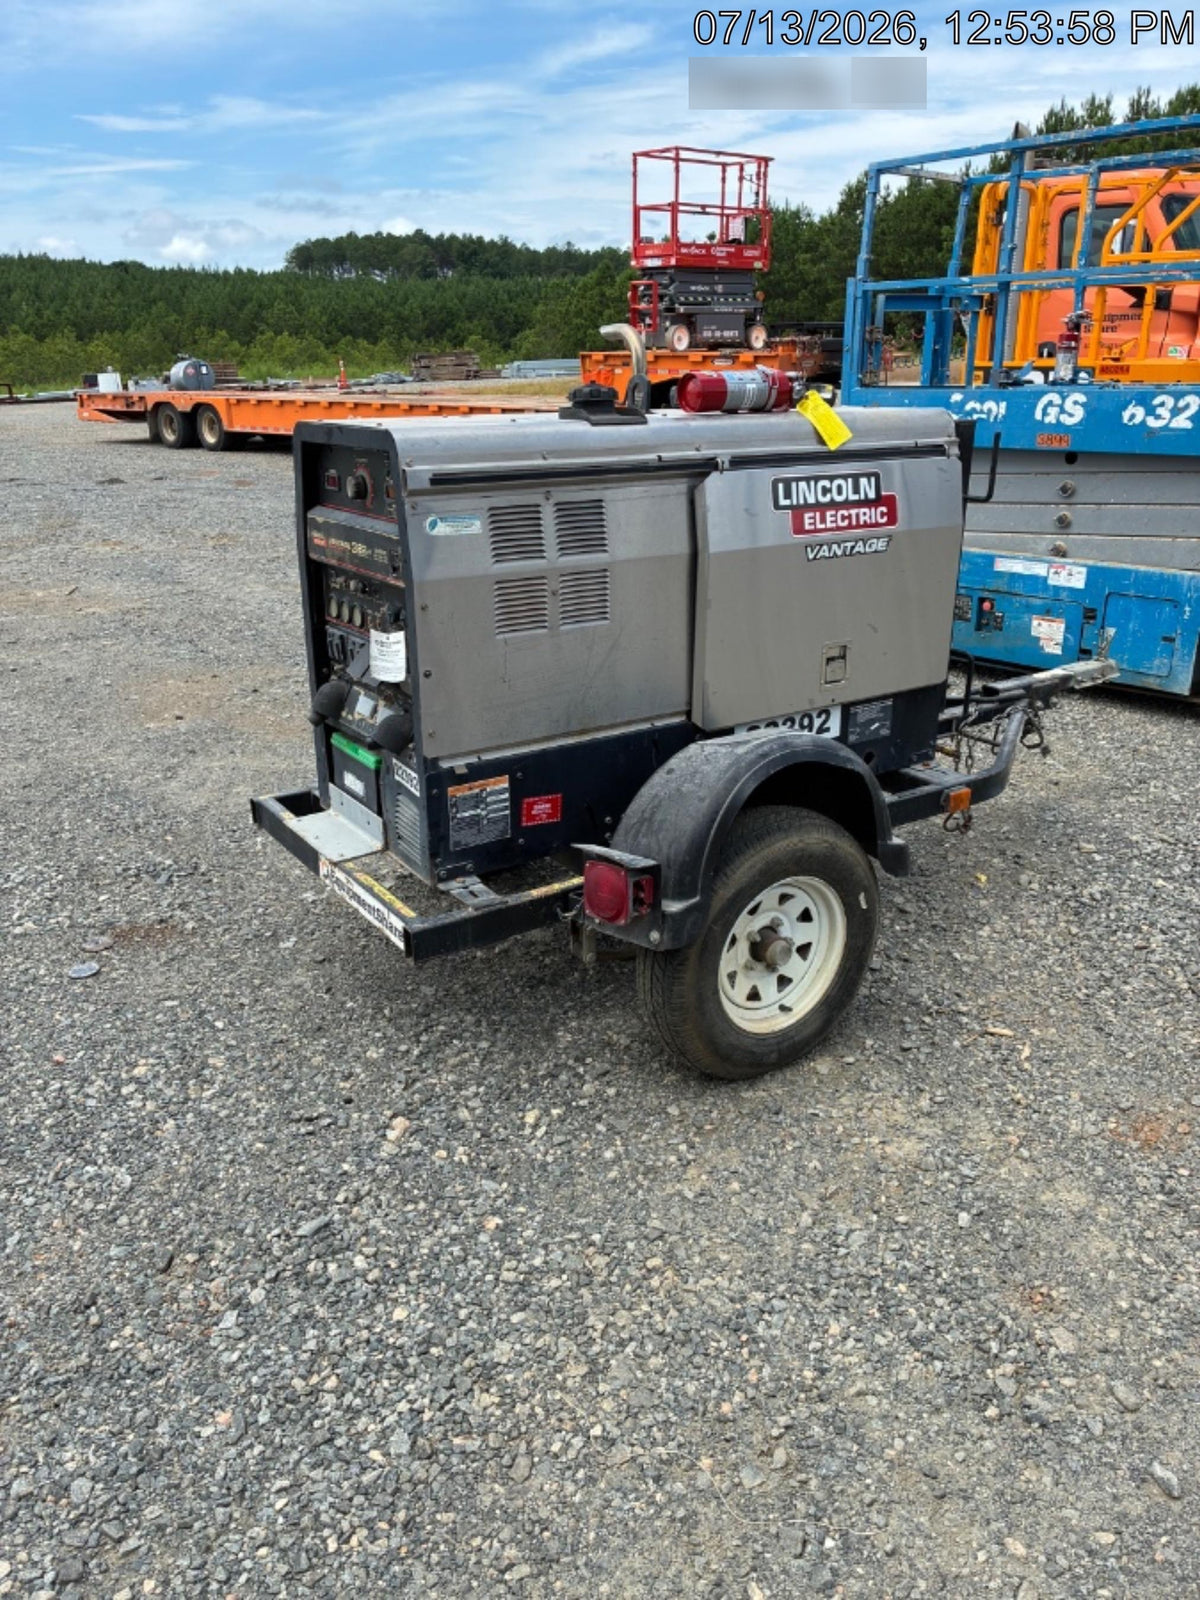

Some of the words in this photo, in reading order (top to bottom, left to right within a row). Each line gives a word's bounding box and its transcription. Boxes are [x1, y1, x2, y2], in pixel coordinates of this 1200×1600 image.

[1034, 392, 1088, 426] GS
[777, 476, 876, 506] LINCOLN
[803, 506, 889, 531] ELECTRIC
[805, 536, 890, 561] VANTAGE
